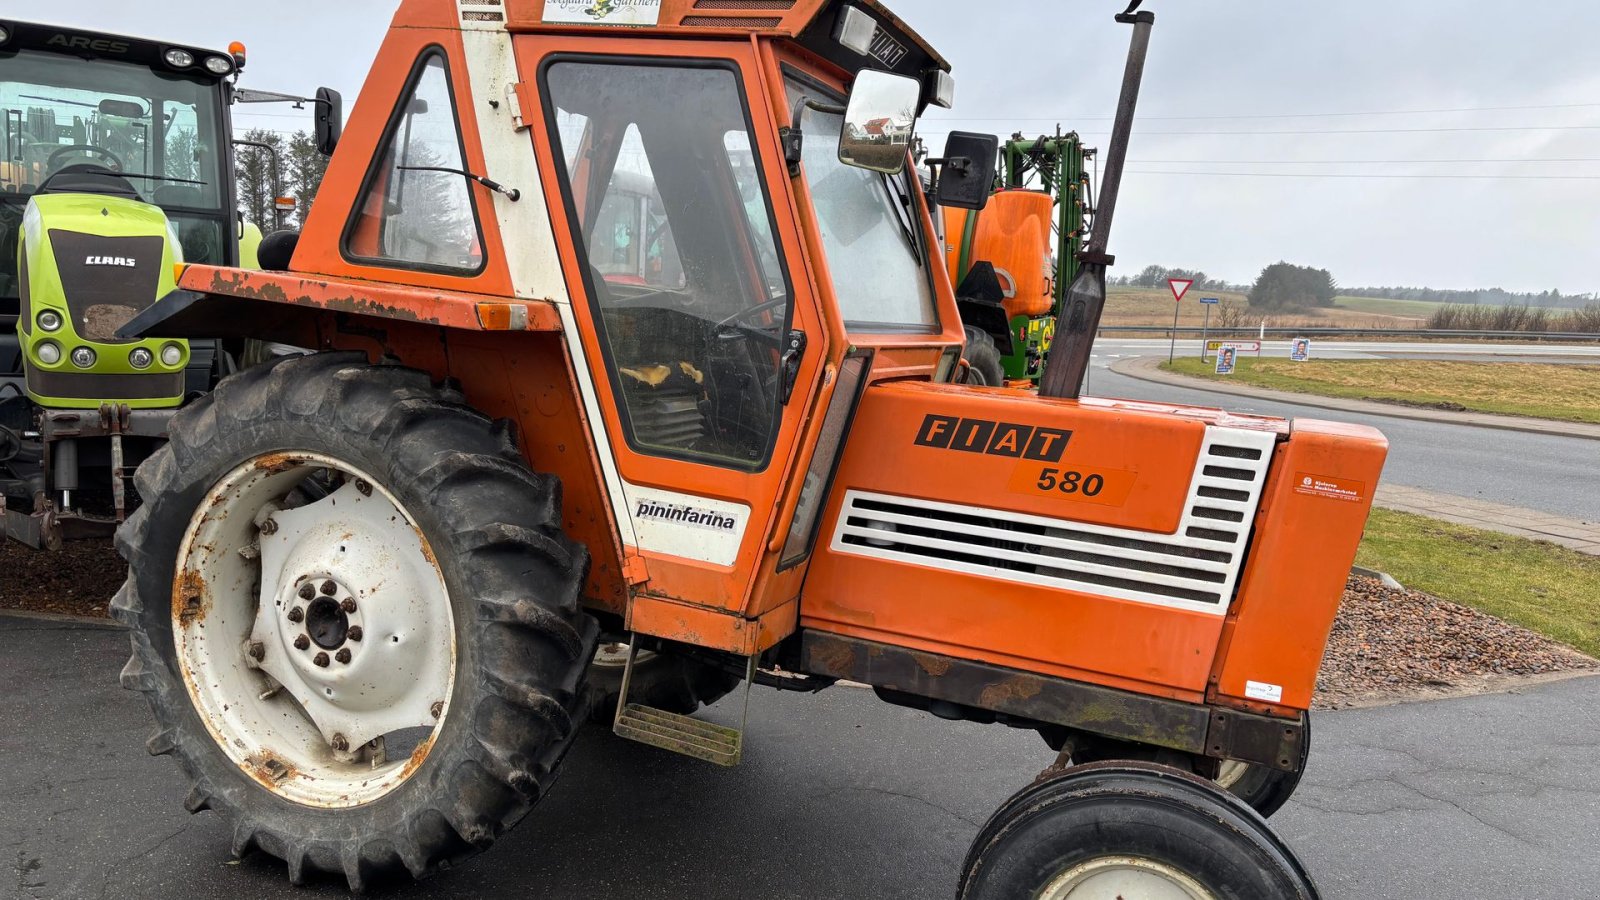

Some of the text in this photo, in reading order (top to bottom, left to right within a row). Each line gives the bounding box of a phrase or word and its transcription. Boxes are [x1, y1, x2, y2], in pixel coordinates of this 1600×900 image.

[47, 34, 130, 53] ARES
[85, 256, 136, 267] CLAAS
[923, 418, 1064, 458] FIAT
[1036, 467, 1104, 497] 580
[636, 501, 735, 529] pininfarina
